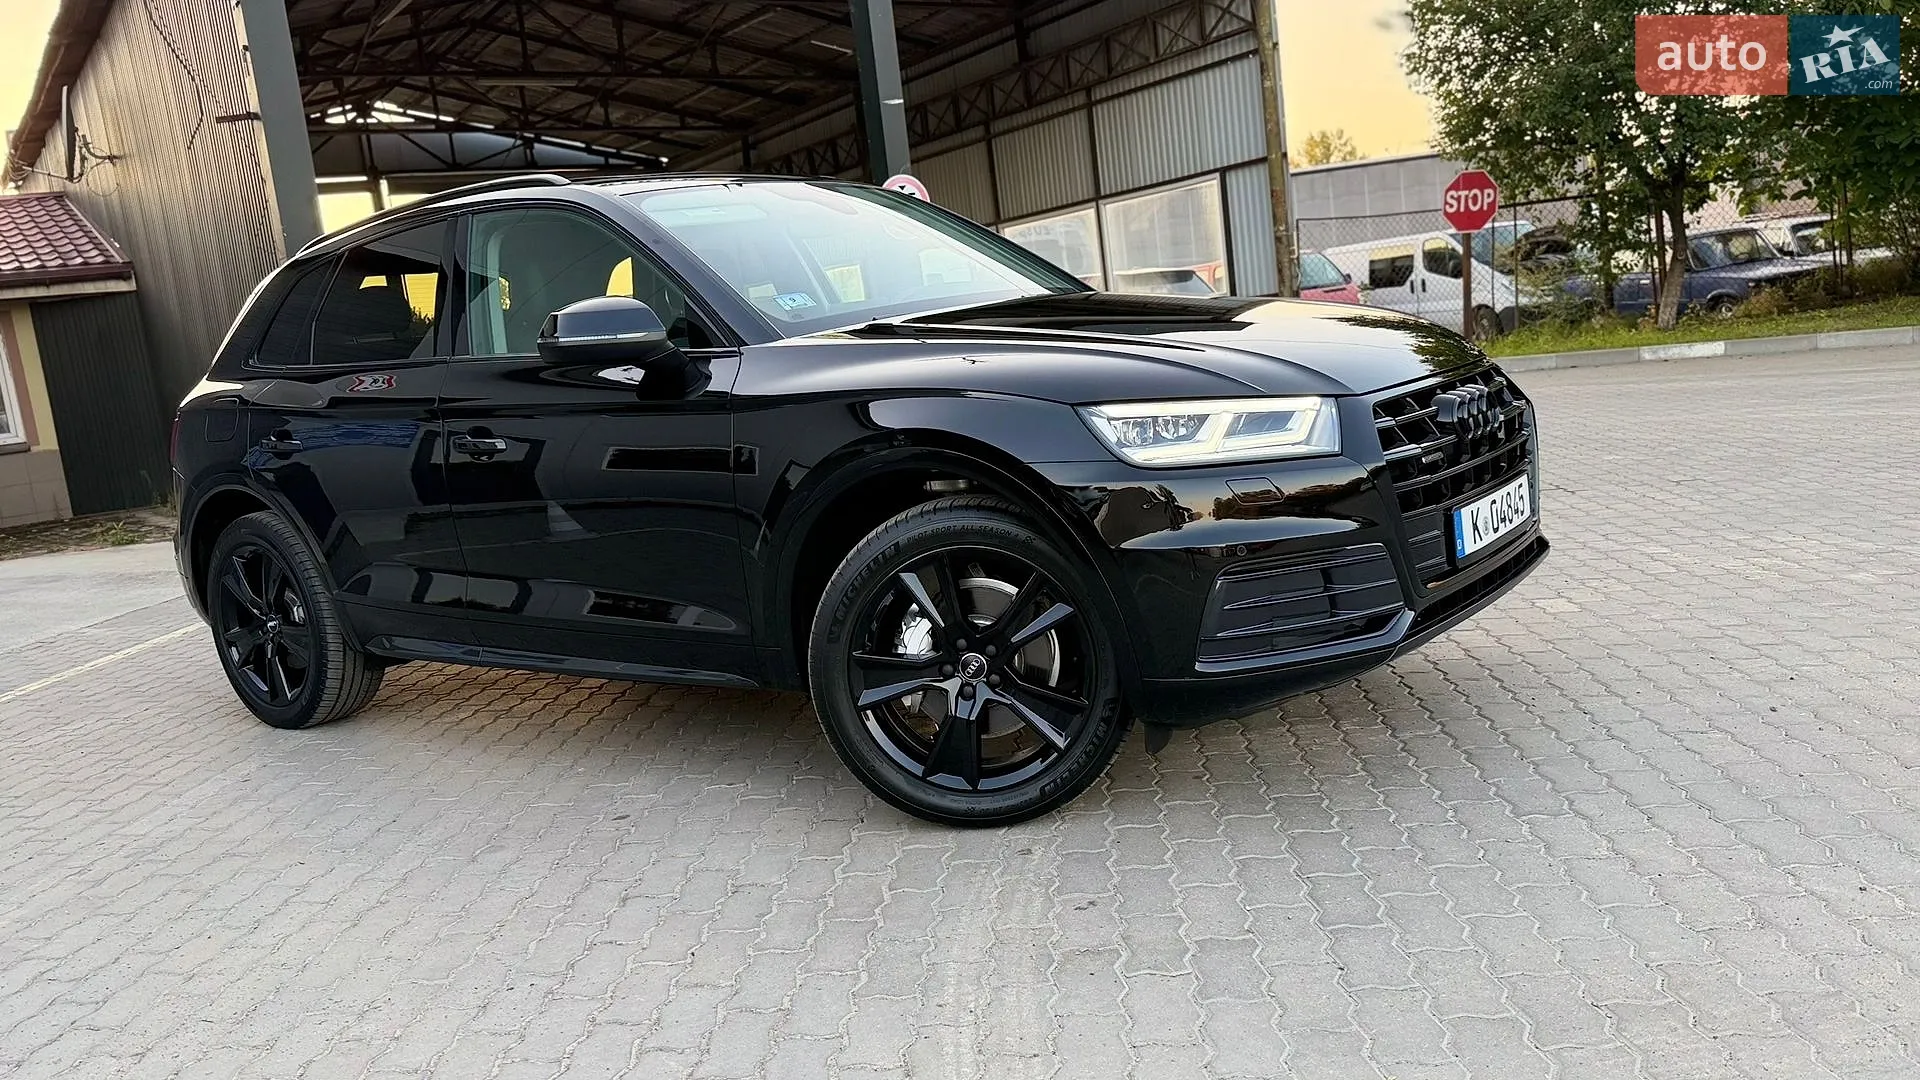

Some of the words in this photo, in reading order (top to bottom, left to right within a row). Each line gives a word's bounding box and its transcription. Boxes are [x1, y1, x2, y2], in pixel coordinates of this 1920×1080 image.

[1445, 188, 1495, 213] STOP
[906, 532, 930, 544] PILOT
[930, 525, 958, 537] SPORT
[959, 524, 975, 532] ALL
[977, 524, 1012, 537] SEASON
[1471, 506, 1483, 545] K
